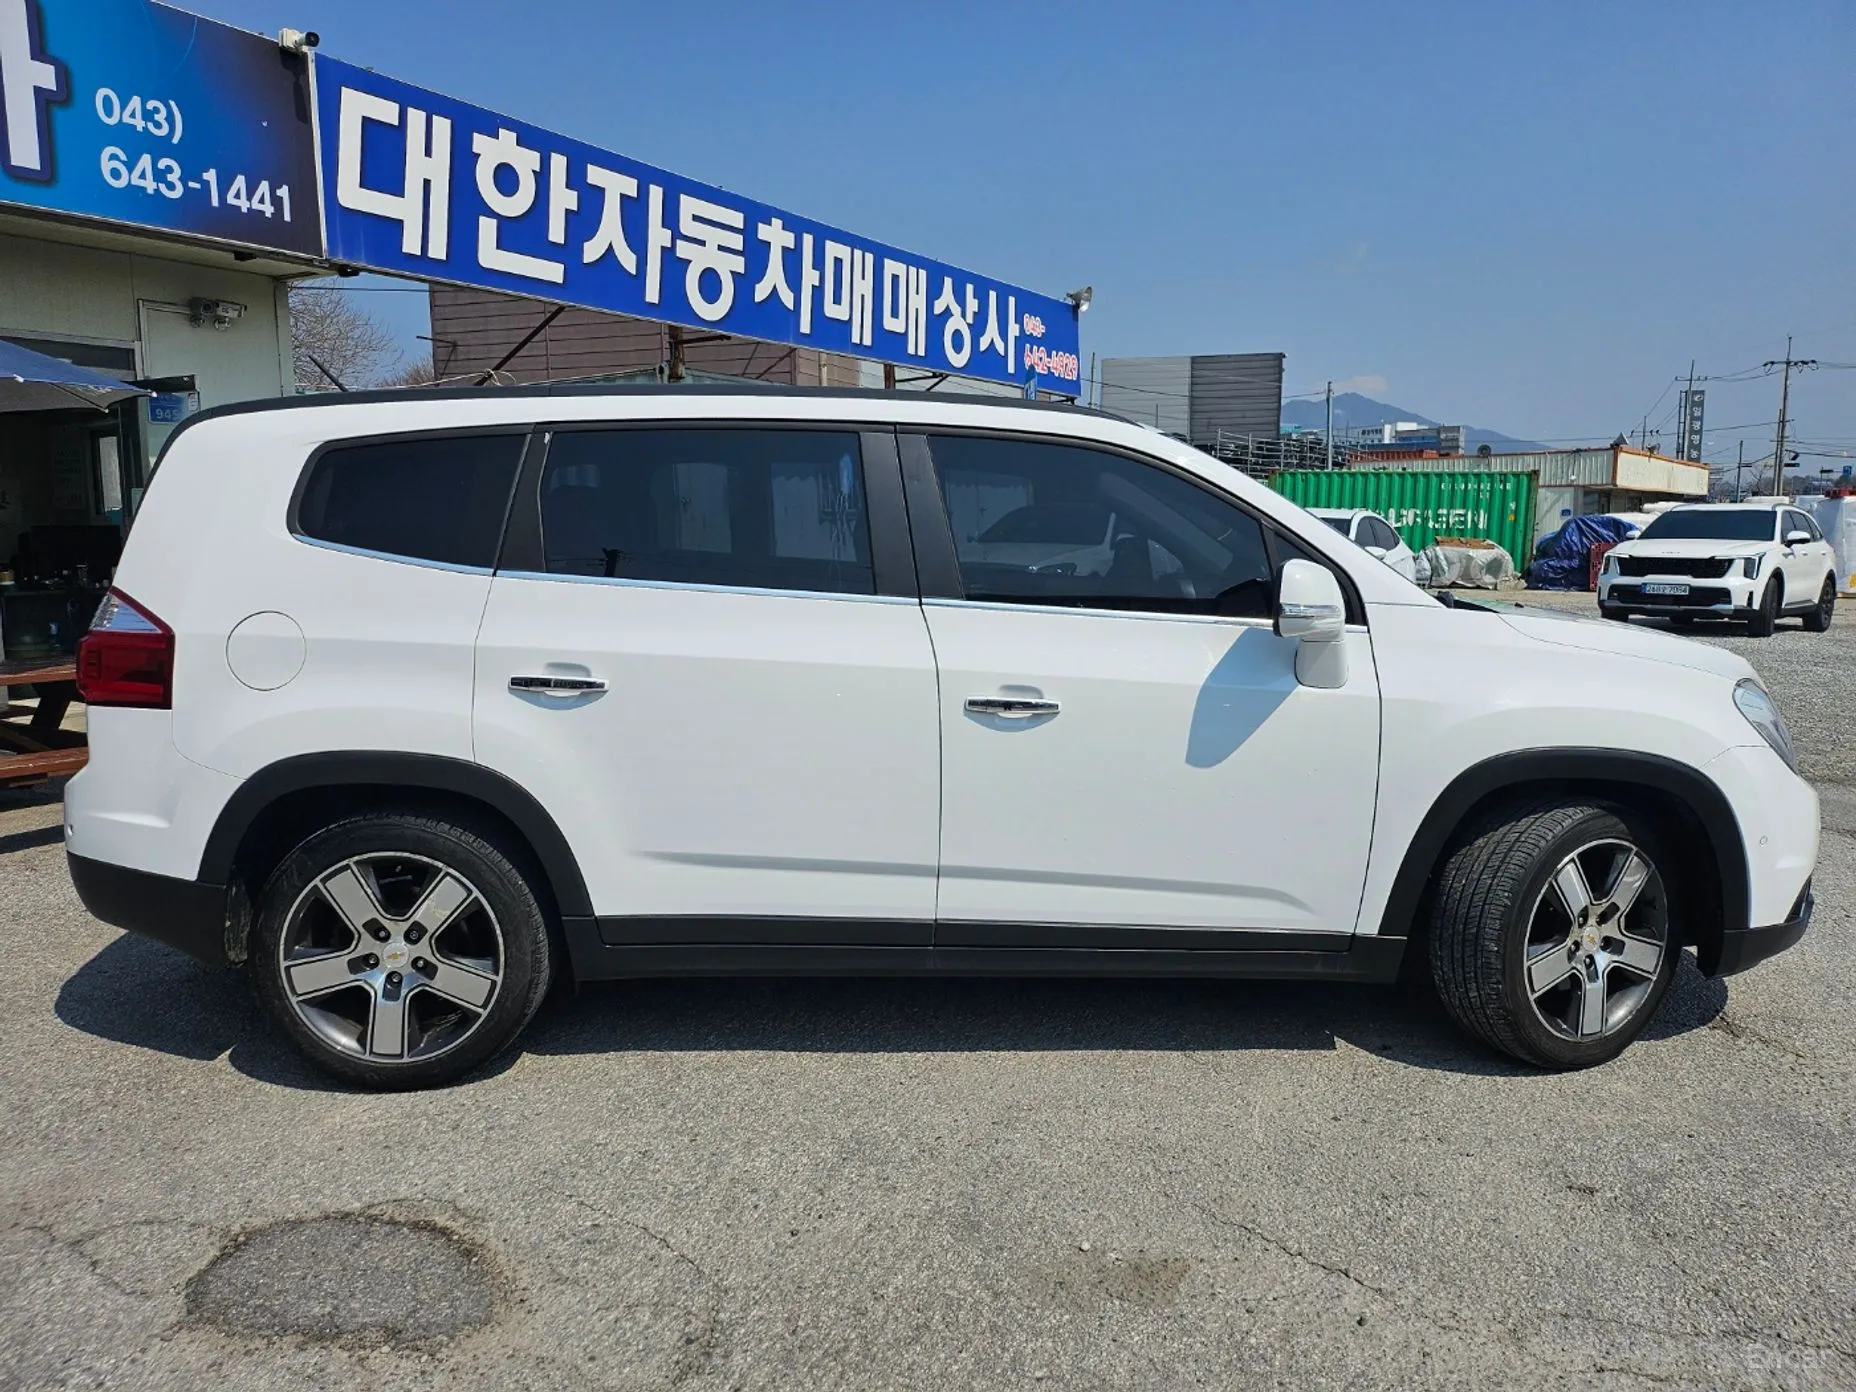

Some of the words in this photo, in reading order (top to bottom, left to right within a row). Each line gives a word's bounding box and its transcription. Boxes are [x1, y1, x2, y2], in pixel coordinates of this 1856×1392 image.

[95, 87, 183, 144] 043)
[100, 146, 292, 222] 643-1441
[336, 86, 1019, 374] 대한자동차매매상사
